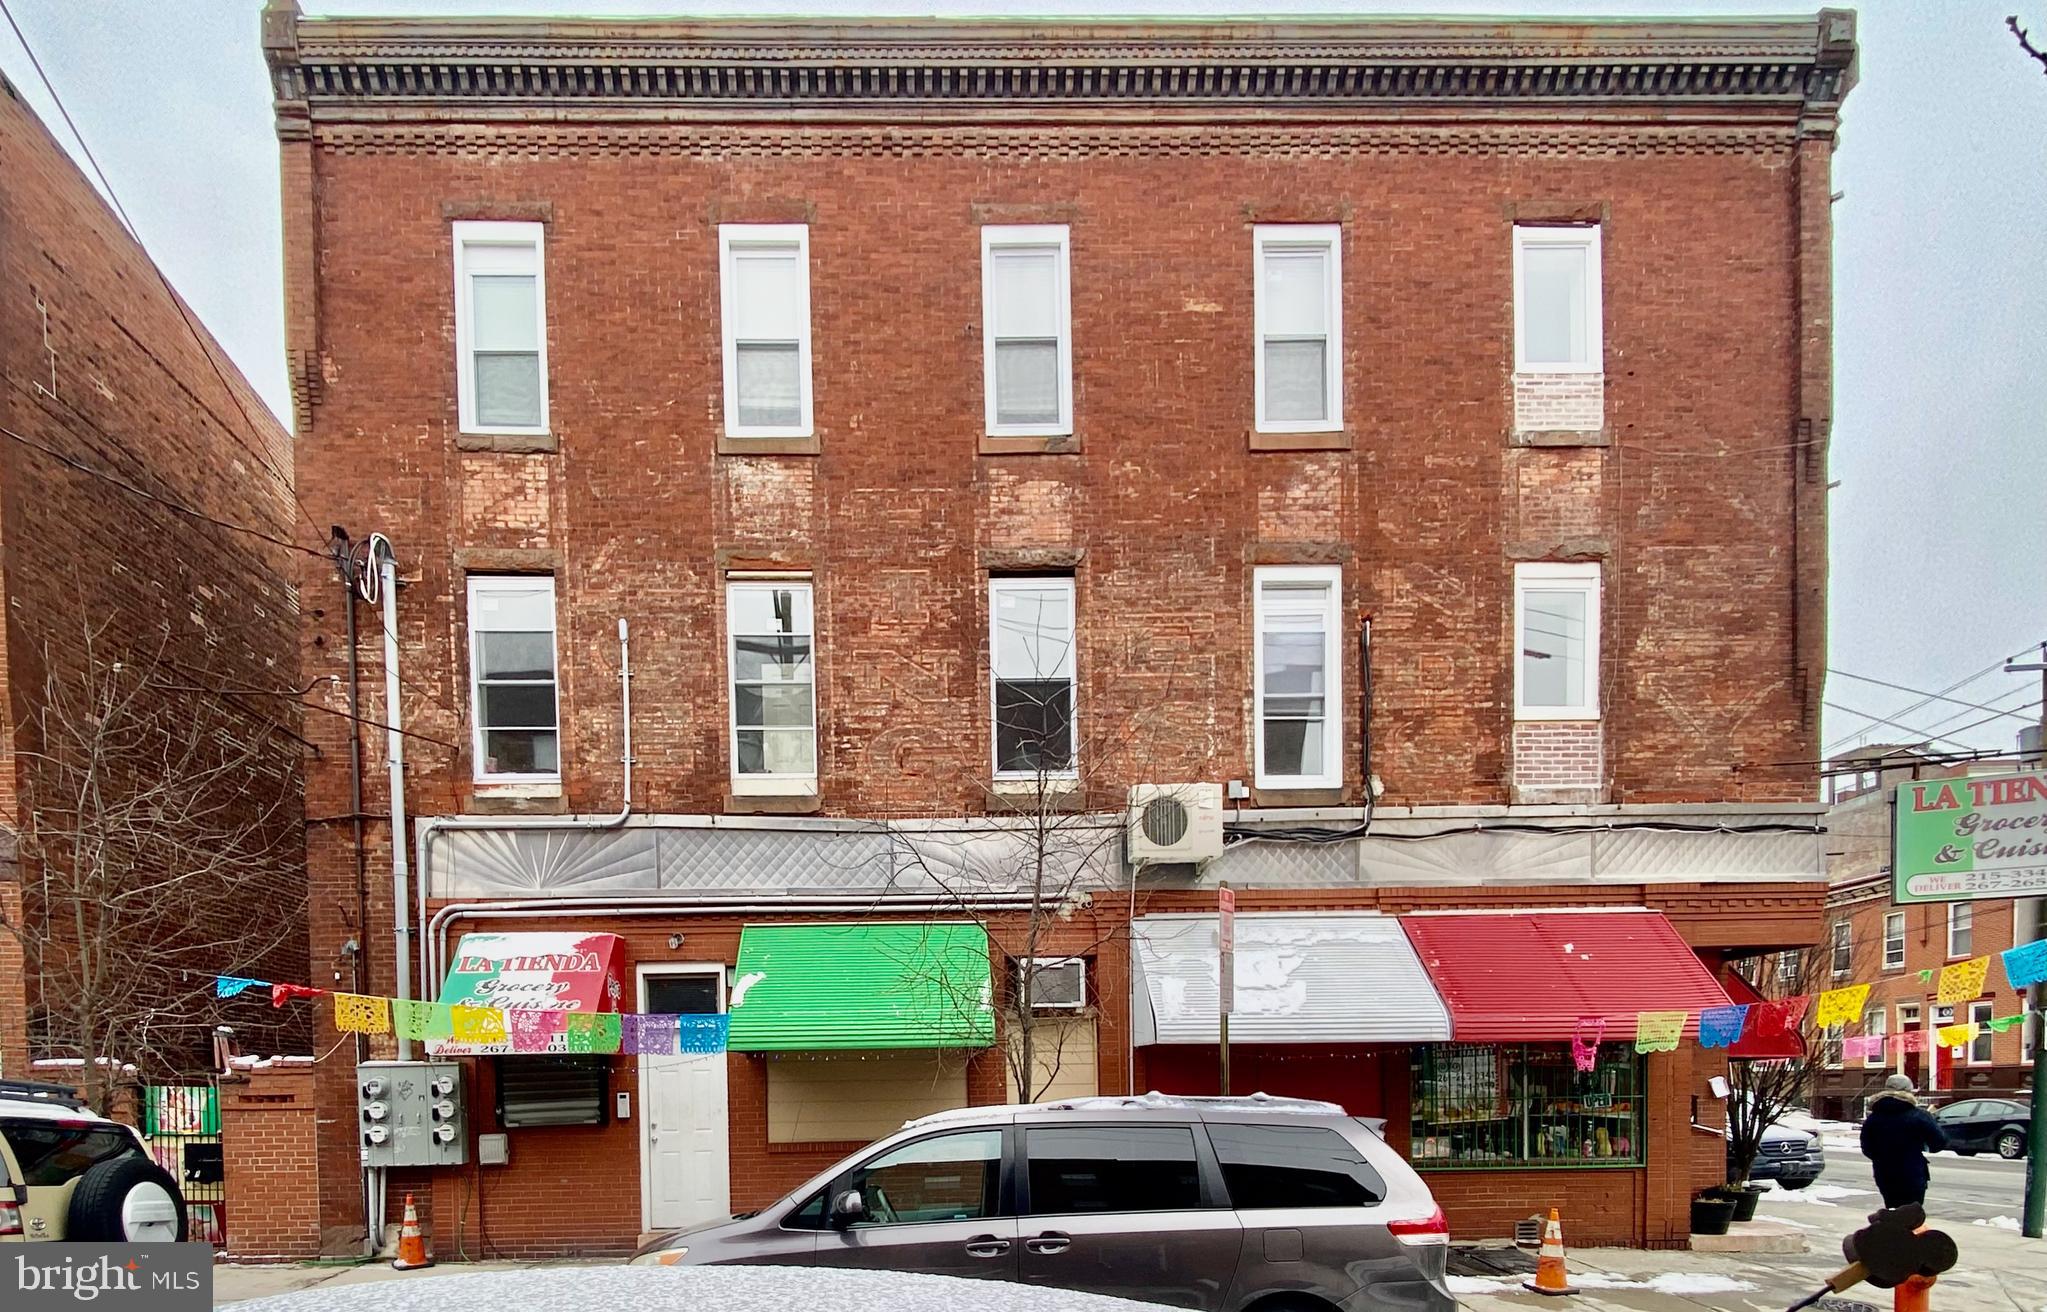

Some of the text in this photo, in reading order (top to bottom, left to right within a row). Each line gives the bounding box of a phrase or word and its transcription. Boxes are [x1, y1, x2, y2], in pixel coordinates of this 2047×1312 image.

[1911, 784, 1961, 812] LA
[1935, 845, 1965, 863] &
[1914, 882, 1962, 893] DELIVER
[457, 953, 600, 972] LA TIENDA
[475, 979, 569, 994] Grocery
[433, 1043, 472, 1055] Deliver
